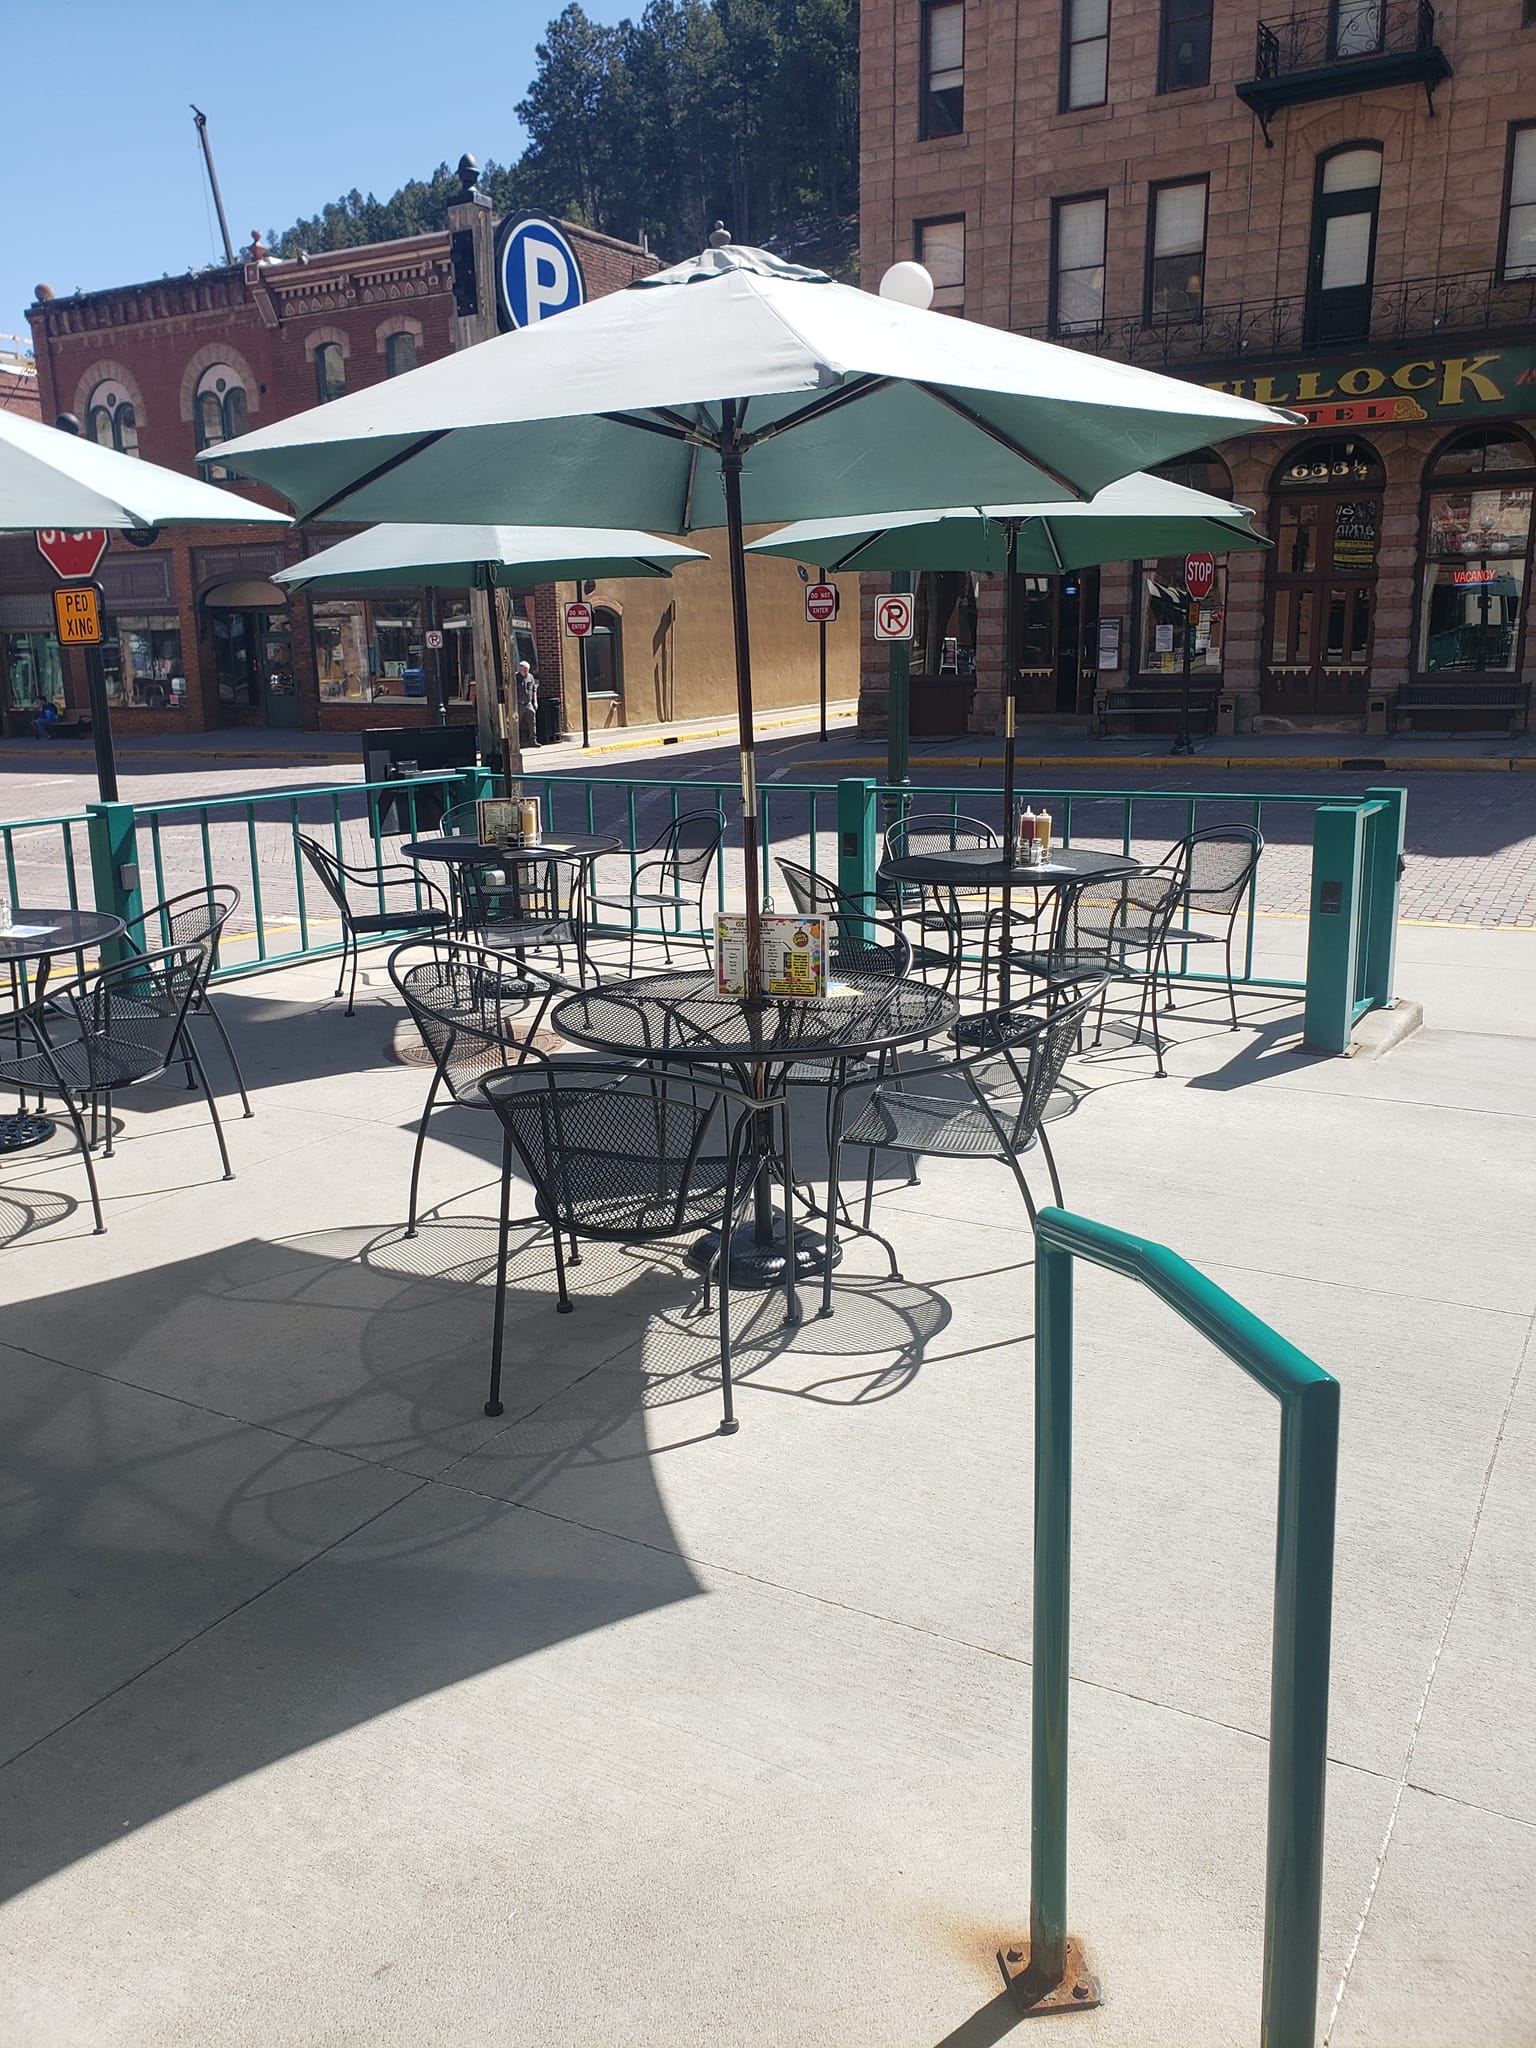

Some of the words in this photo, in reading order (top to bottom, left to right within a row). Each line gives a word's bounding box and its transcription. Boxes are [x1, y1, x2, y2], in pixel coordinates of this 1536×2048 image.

[523, 237, 569, 326] P
[1206, 355, 1505, 406] LLOCK
[1307, 405, 1387, 423] TEL
[1187, 561, 1212, 582] STOP
[1453, 569, 1496, 584] VACANCY
[66, 594, 88, 613] PED
[820, 591, 831, 599] NOT
[66, 618, 93, 638] XING
